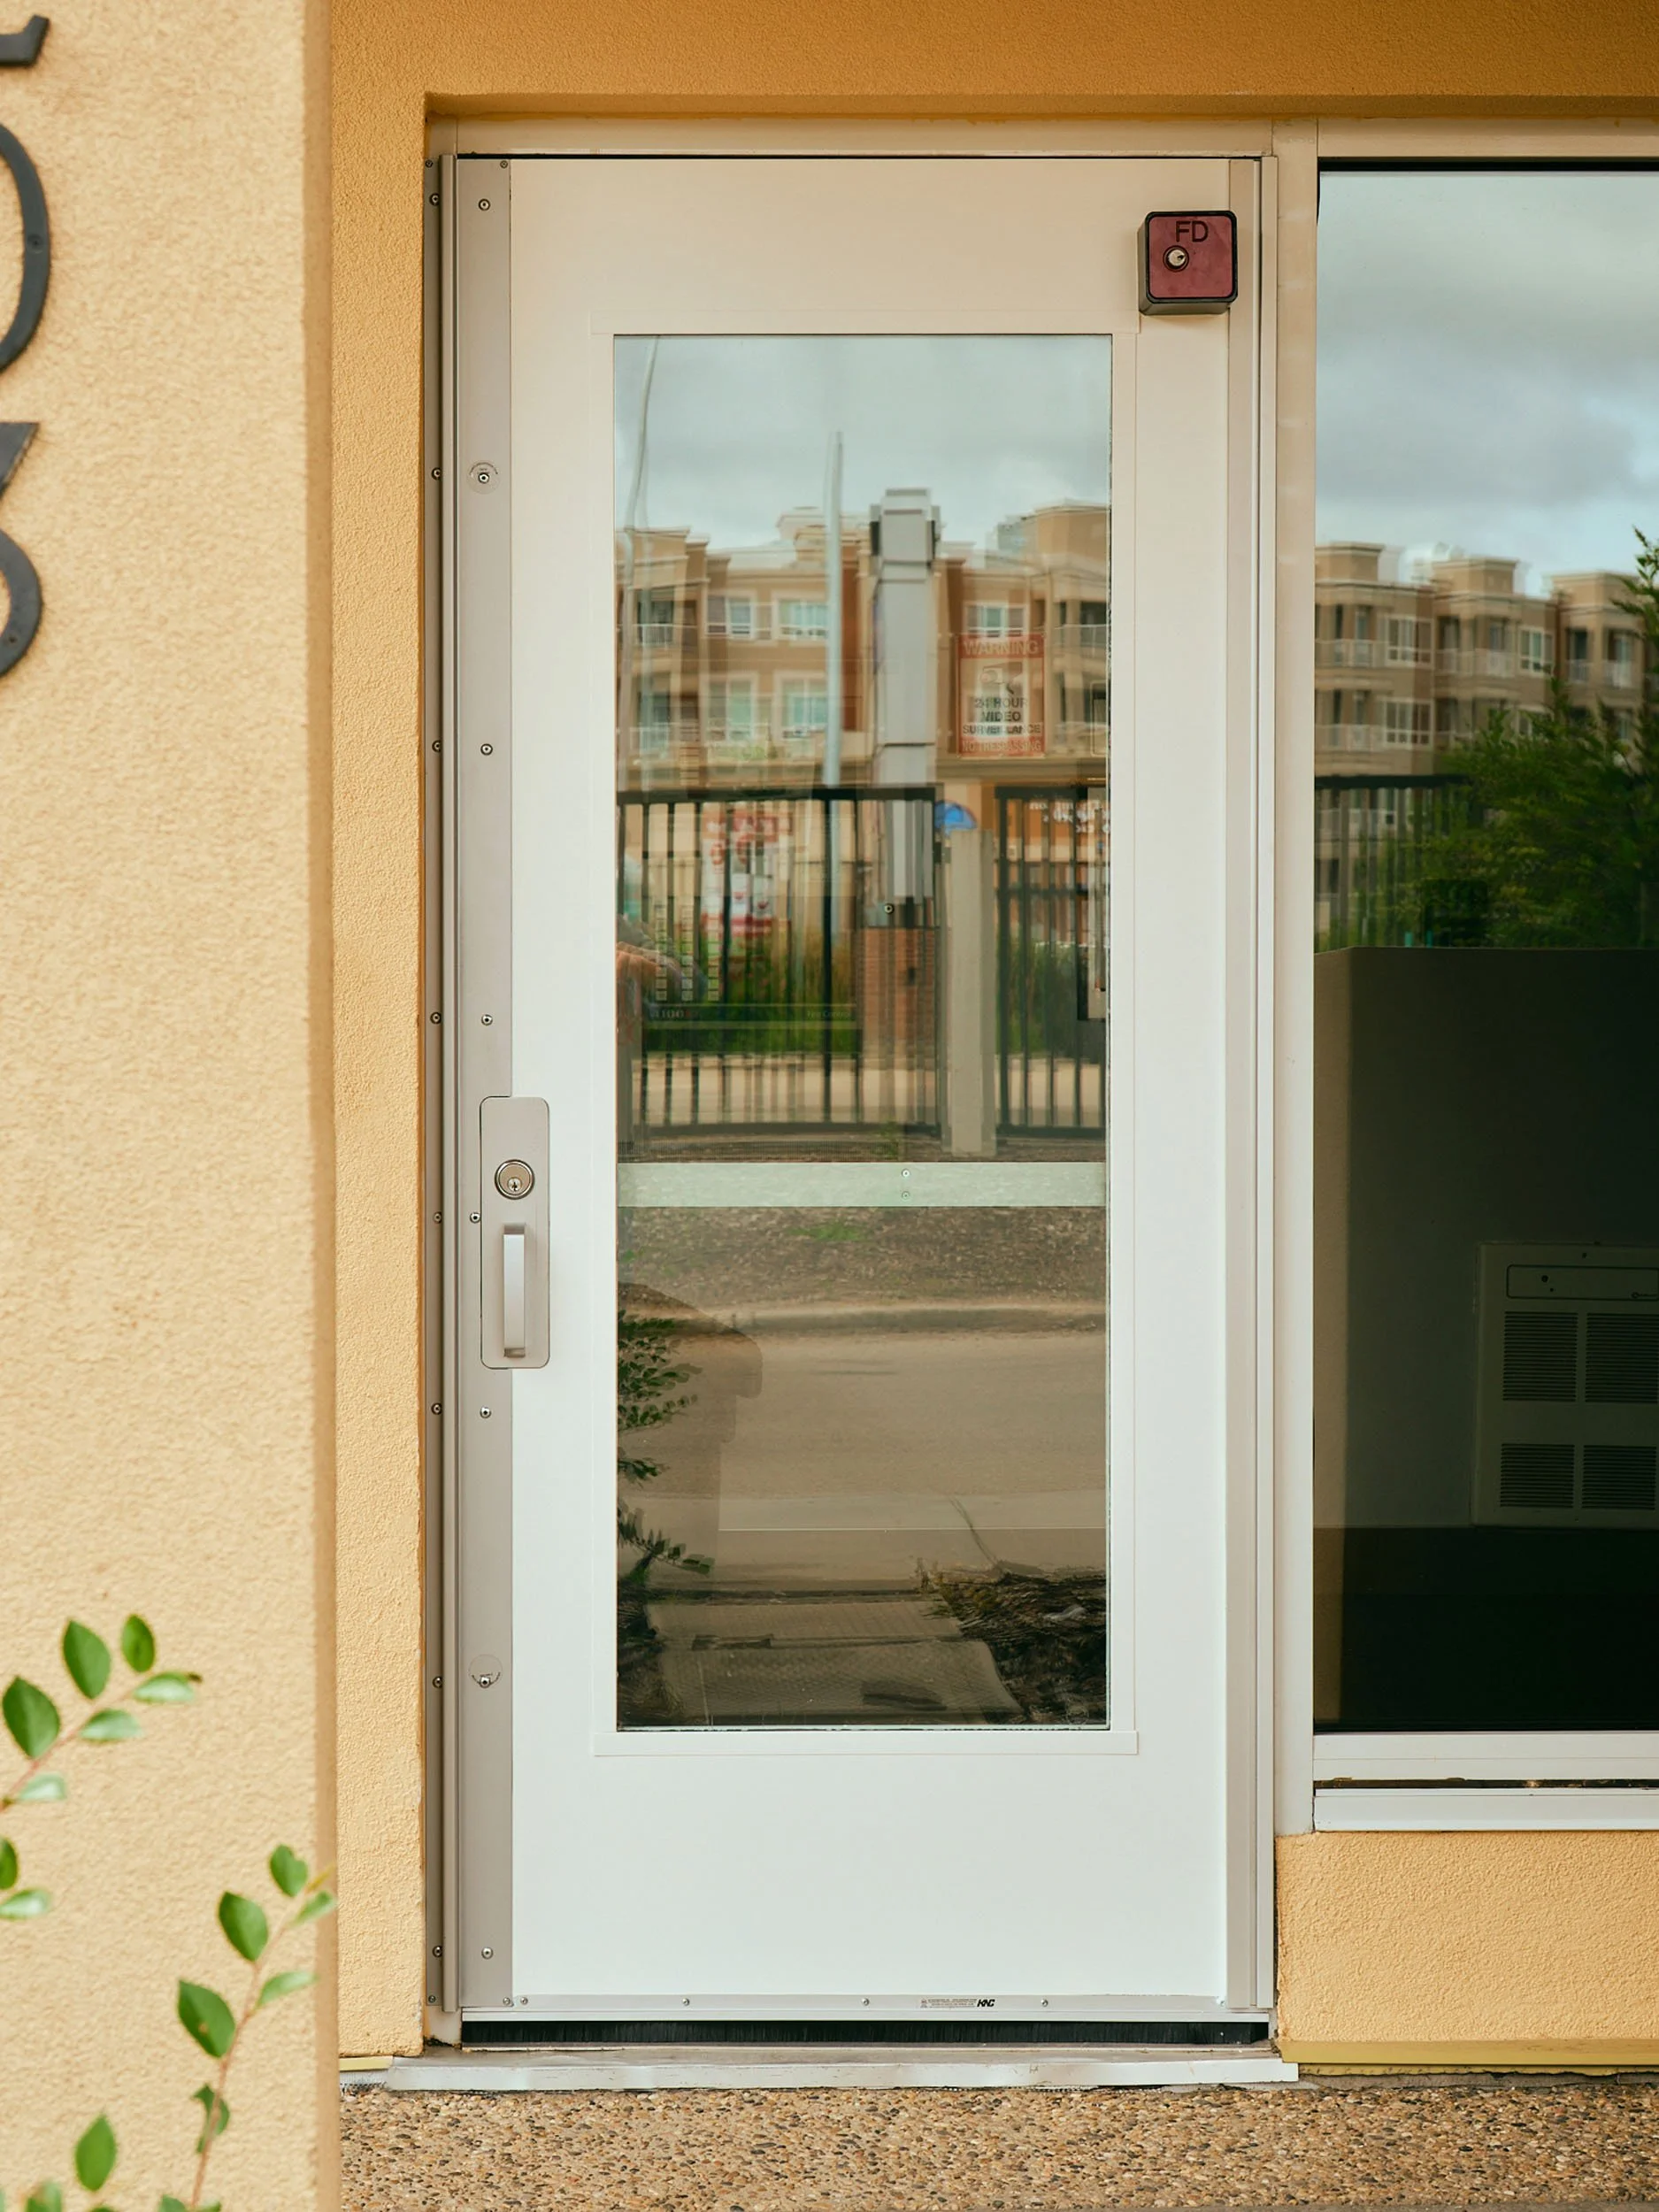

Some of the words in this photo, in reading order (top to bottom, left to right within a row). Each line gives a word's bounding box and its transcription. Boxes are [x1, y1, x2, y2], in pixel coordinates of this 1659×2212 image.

[1175, 220, 1209, 242] FD
[964, 640, 1039, 656] WARNING
[992, 695, 1028, 709] HOUR
[981, 710, 1021, 722] VIDEO
[963, 725, 1041, 734] SURVEILLANCE
